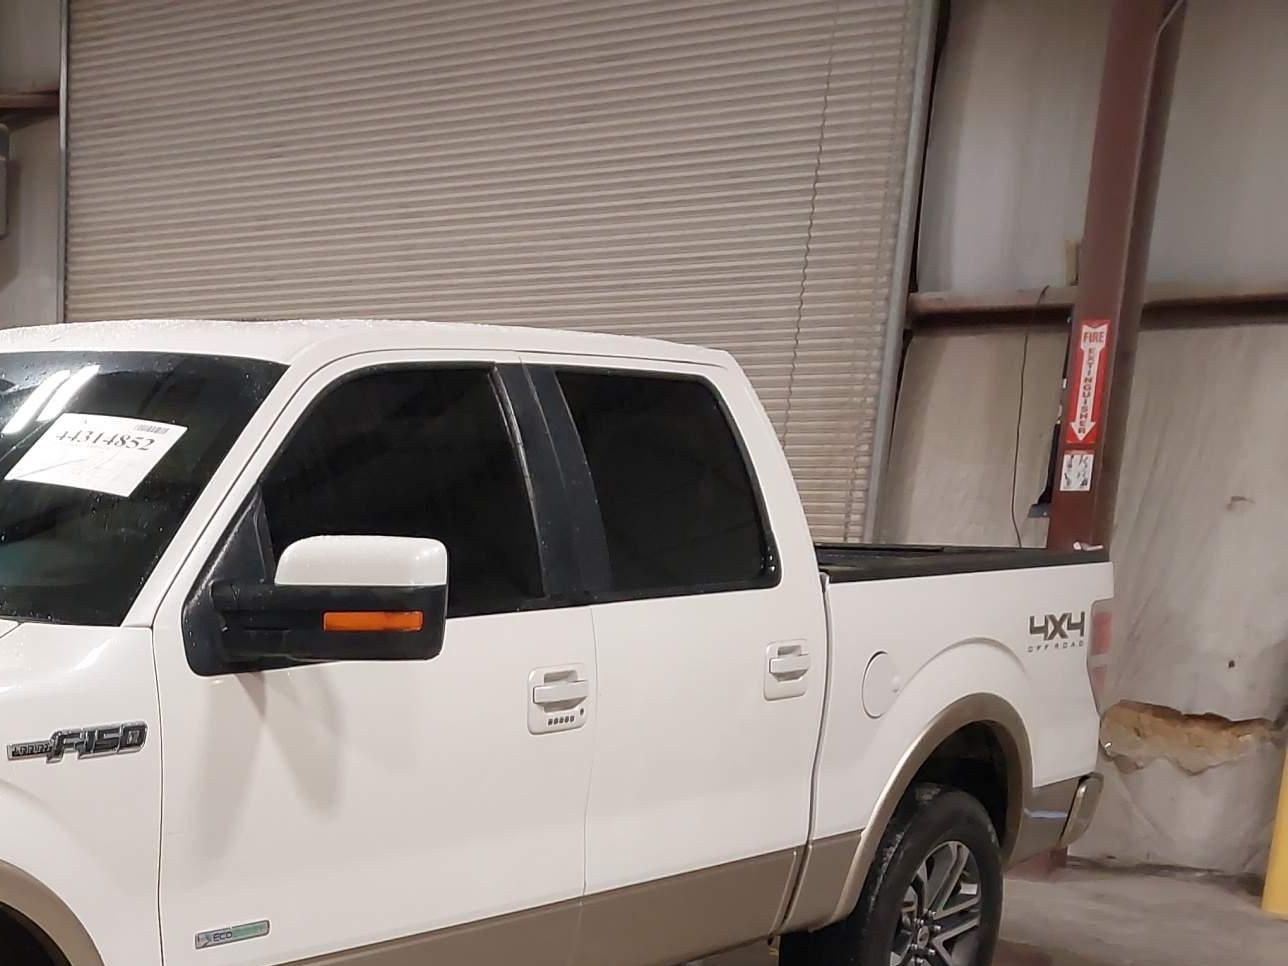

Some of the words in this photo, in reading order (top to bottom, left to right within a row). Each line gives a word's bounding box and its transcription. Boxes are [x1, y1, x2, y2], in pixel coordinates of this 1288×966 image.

[1083, 331, 1104, 343] FIRE
[1077, 348, 1094, 434] EXTINGUISHER
[55, 430, 156, 451] 44314852
